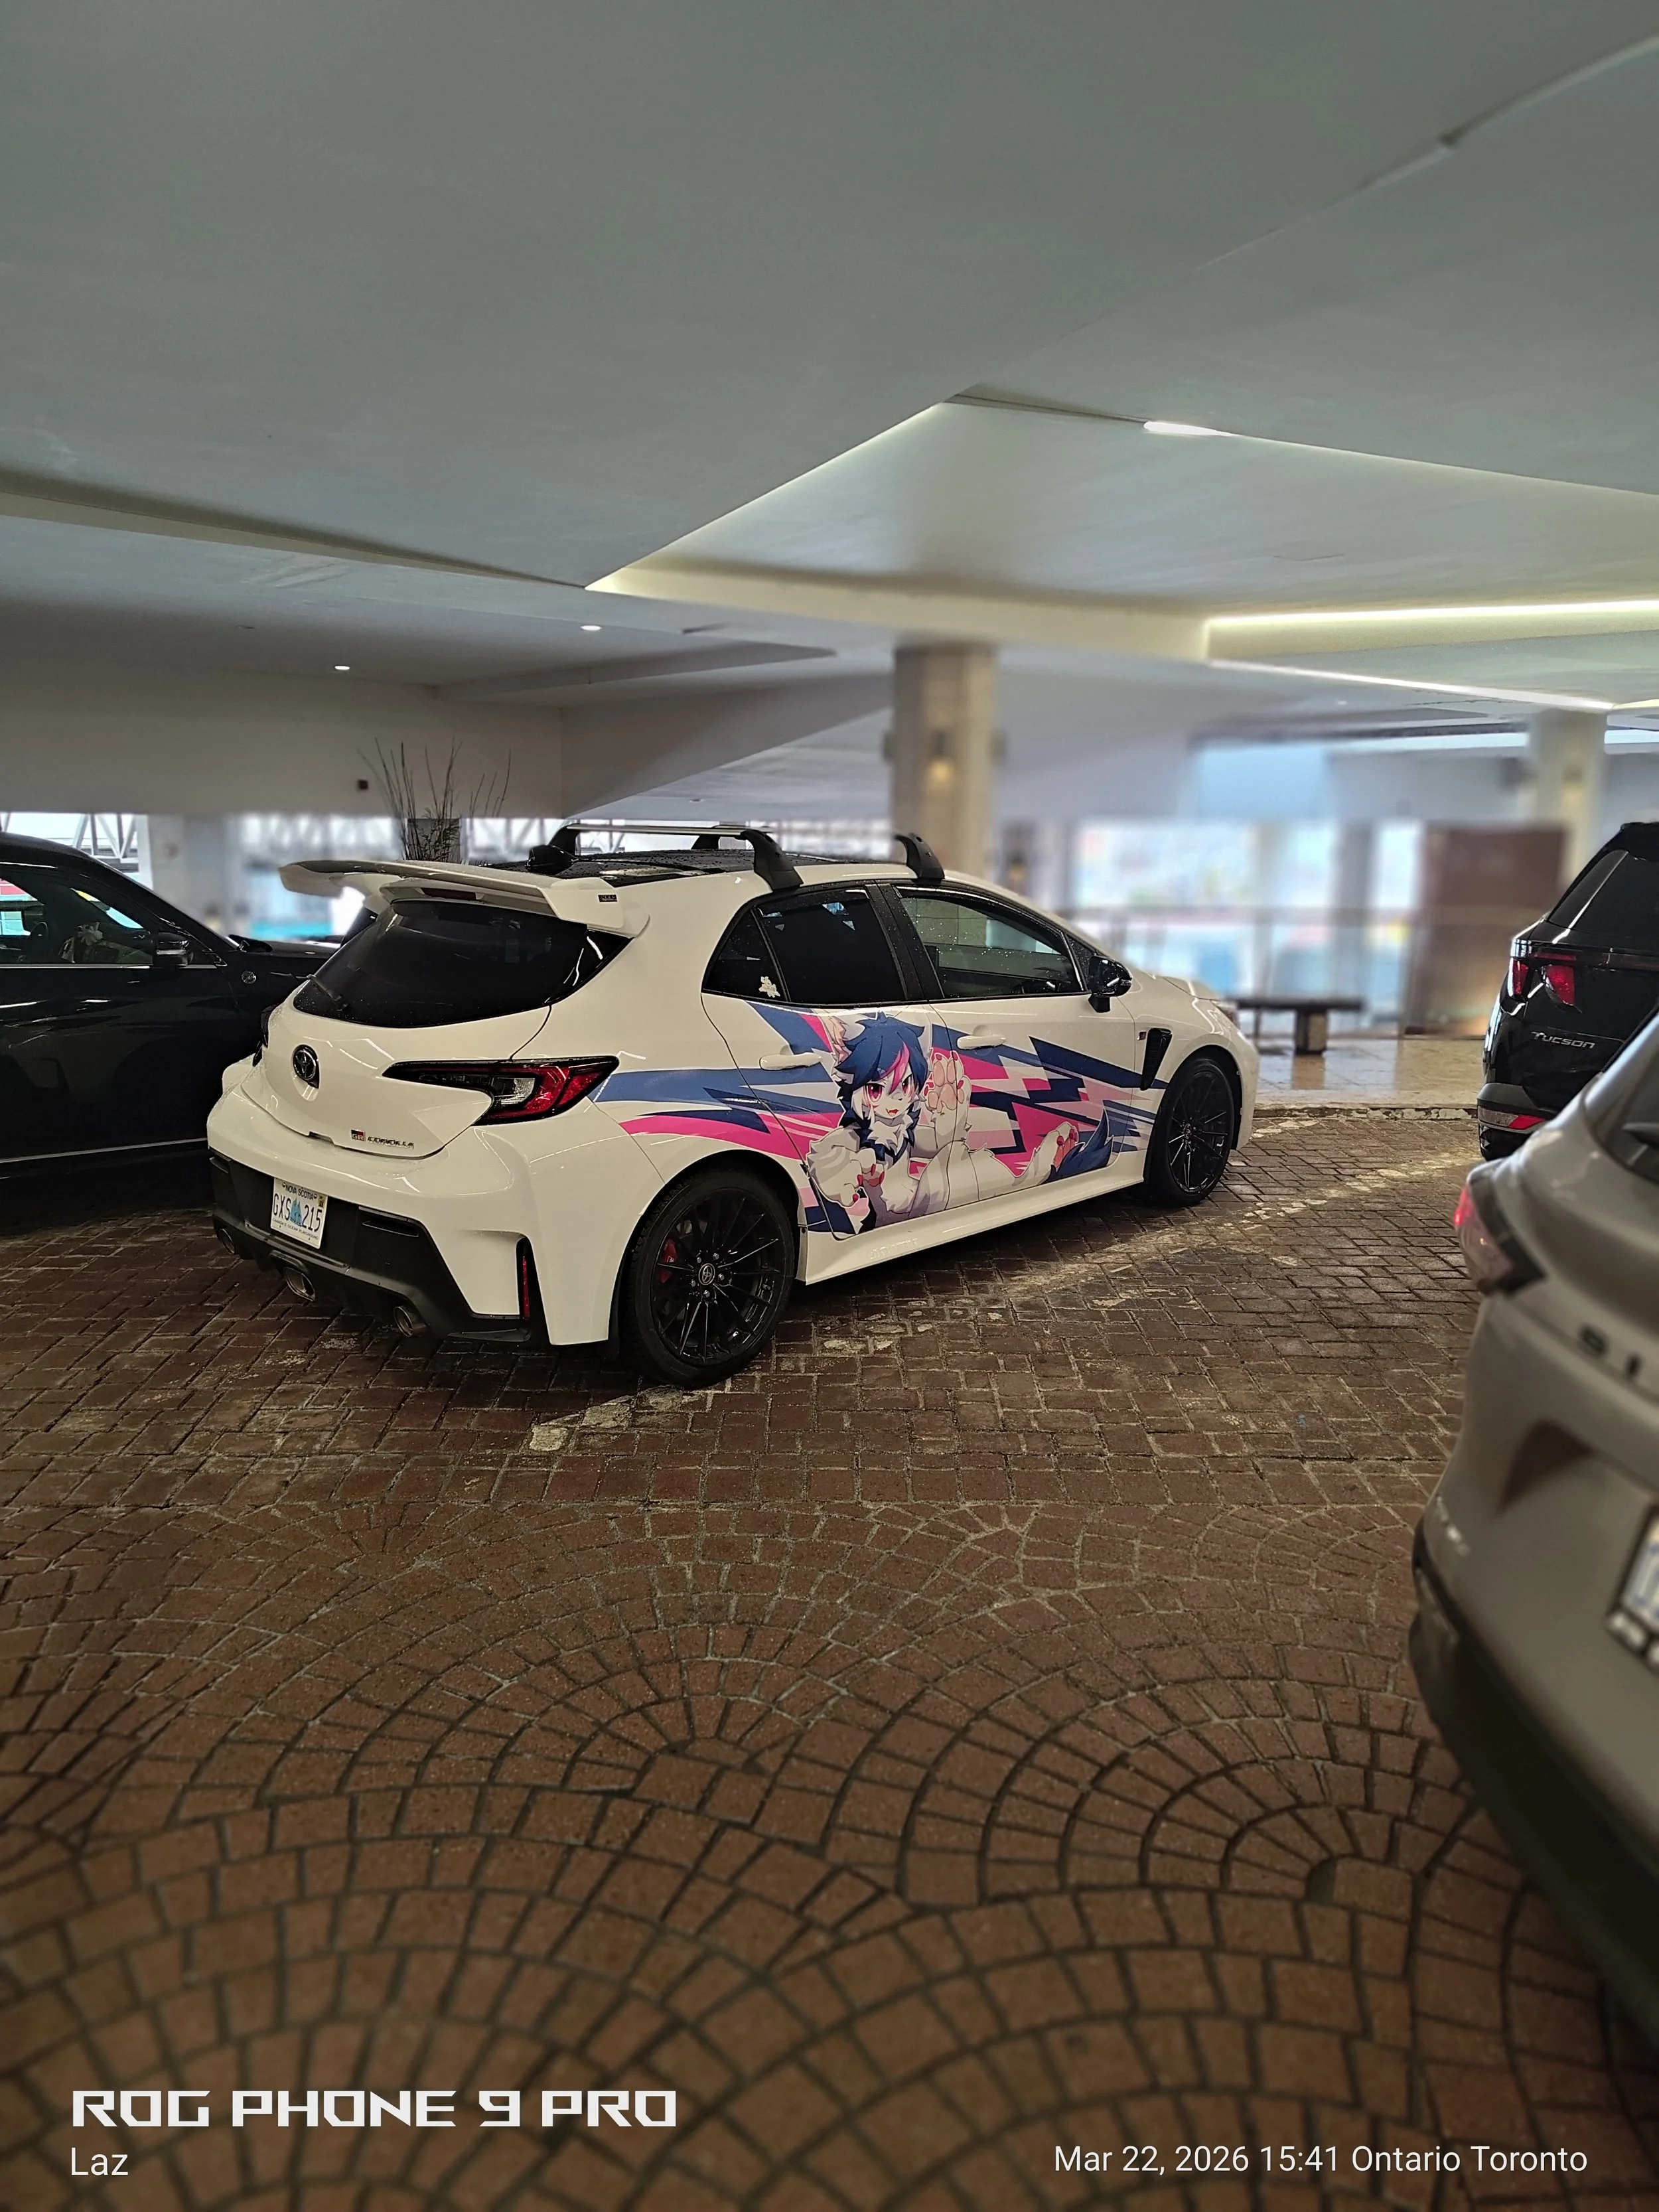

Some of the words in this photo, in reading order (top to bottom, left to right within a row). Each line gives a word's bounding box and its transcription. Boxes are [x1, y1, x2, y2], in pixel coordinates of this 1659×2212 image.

[367, 1136, 415, 1149] COROLLA
[285, 1184, 297, 1195] NOVA
[297, 1189, 315, 1201] SCOTIA
[273, 1193, 292, 1221] GXS
[302, 1204, 323, 1232] 215
